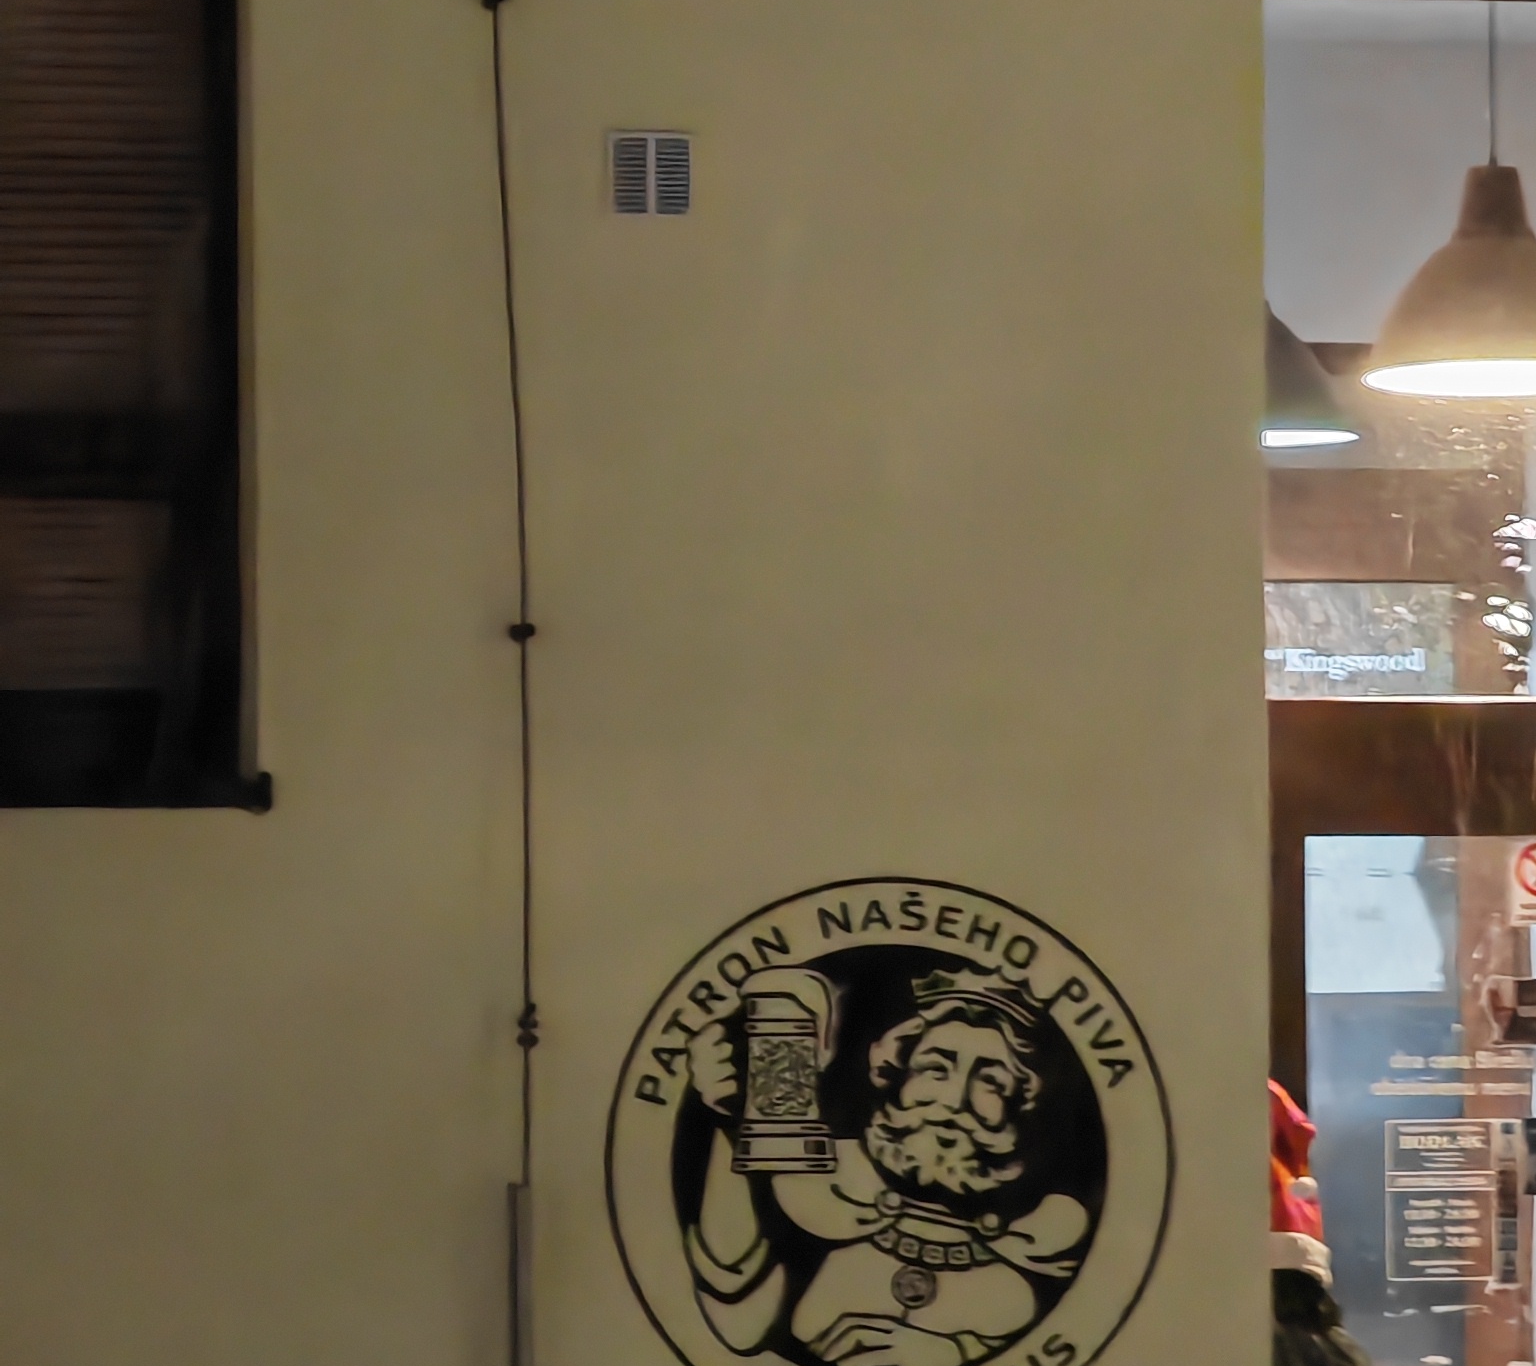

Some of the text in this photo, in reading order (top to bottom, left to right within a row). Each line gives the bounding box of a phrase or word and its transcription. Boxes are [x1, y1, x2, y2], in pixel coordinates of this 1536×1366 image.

[635, 891, 1138, 1106] PATRON NAŠEHO PIVA
